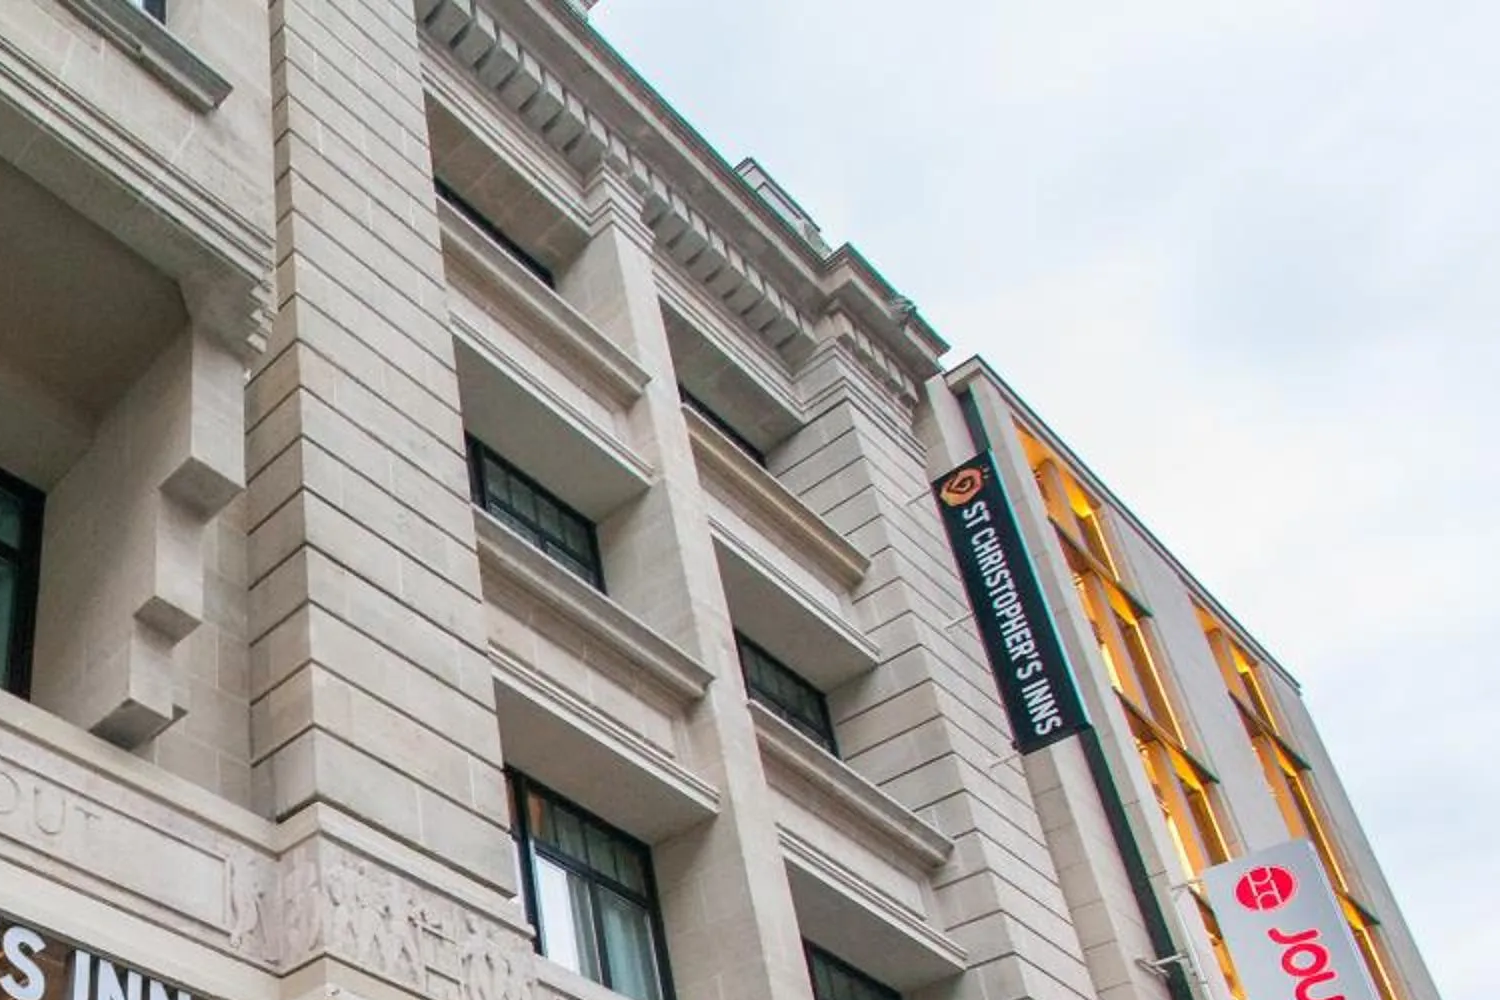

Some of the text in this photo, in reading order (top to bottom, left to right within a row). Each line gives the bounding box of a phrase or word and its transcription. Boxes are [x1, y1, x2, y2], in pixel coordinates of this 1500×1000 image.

[963, 501, 1063, 736] ST CHRISTOPHER'S INNS
